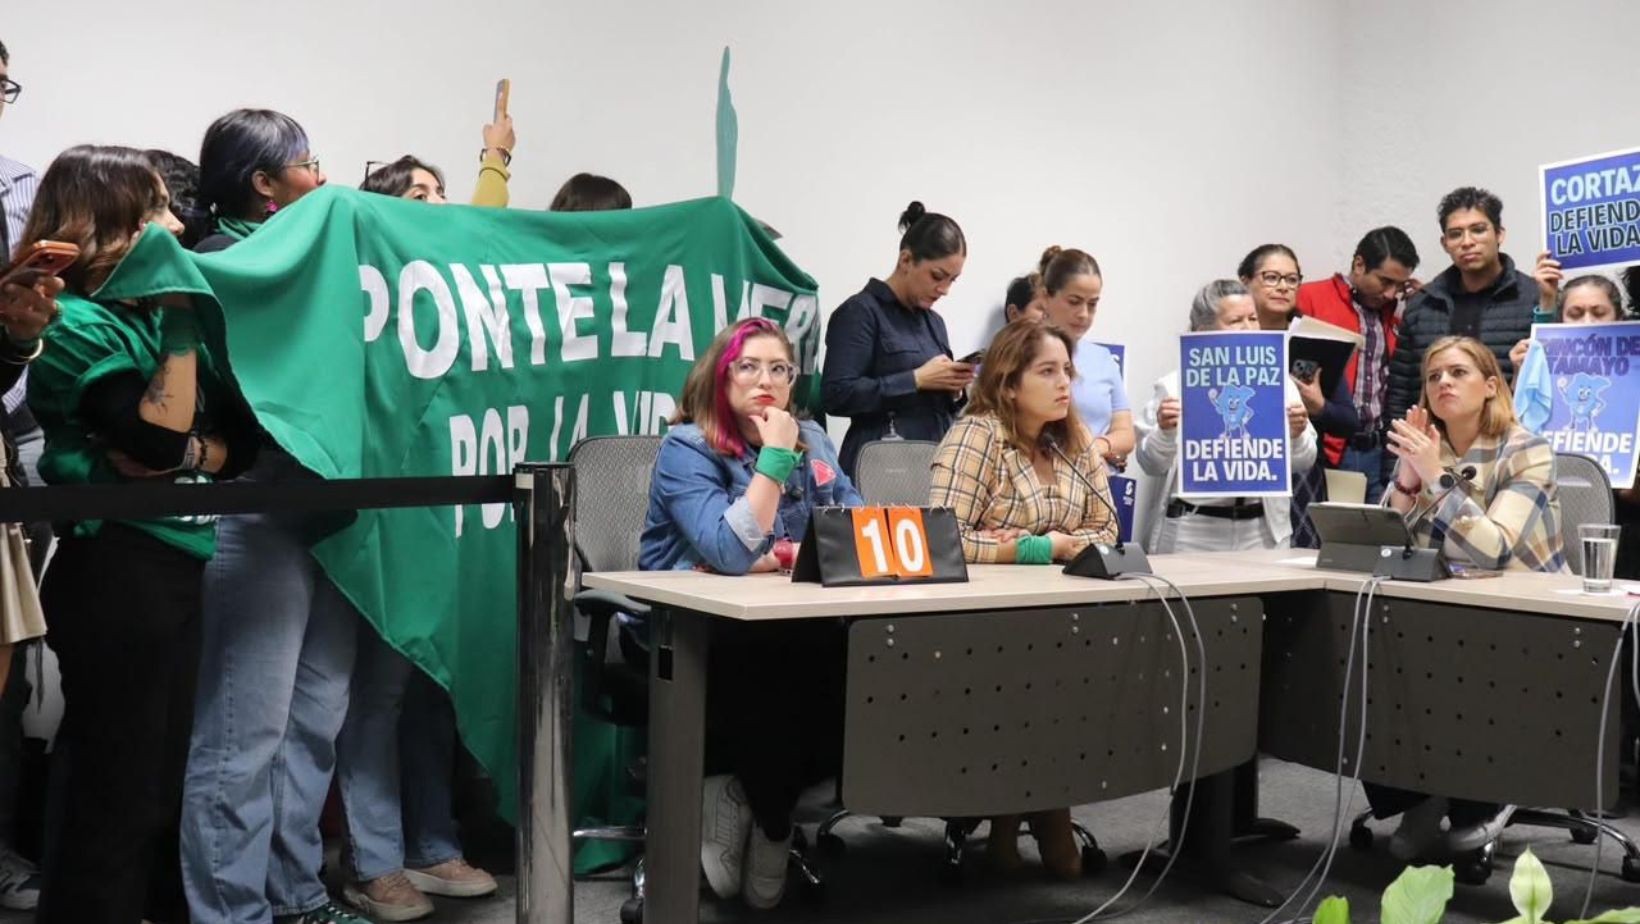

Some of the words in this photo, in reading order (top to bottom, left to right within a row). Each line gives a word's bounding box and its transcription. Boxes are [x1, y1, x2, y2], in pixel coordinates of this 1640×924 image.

[1556, 233, 1584, 257] LA
[608, 261, 695, 361] LA
[1189, 348, 1229, 367] SAN
[1236, 346, 1276, 365] LUIS
[1186, 368, 1211, 387] DE
[1216, 368, 1240, 386] LA
[1246, 367, 1280, 386] PAZ
[1186, 438, 1283, 460] DEFIENDE
[1193, 462, 1218, 482] LA
[1222, 460, 1277, 481] VIDA.
[861, 518, 923, 573] 10
